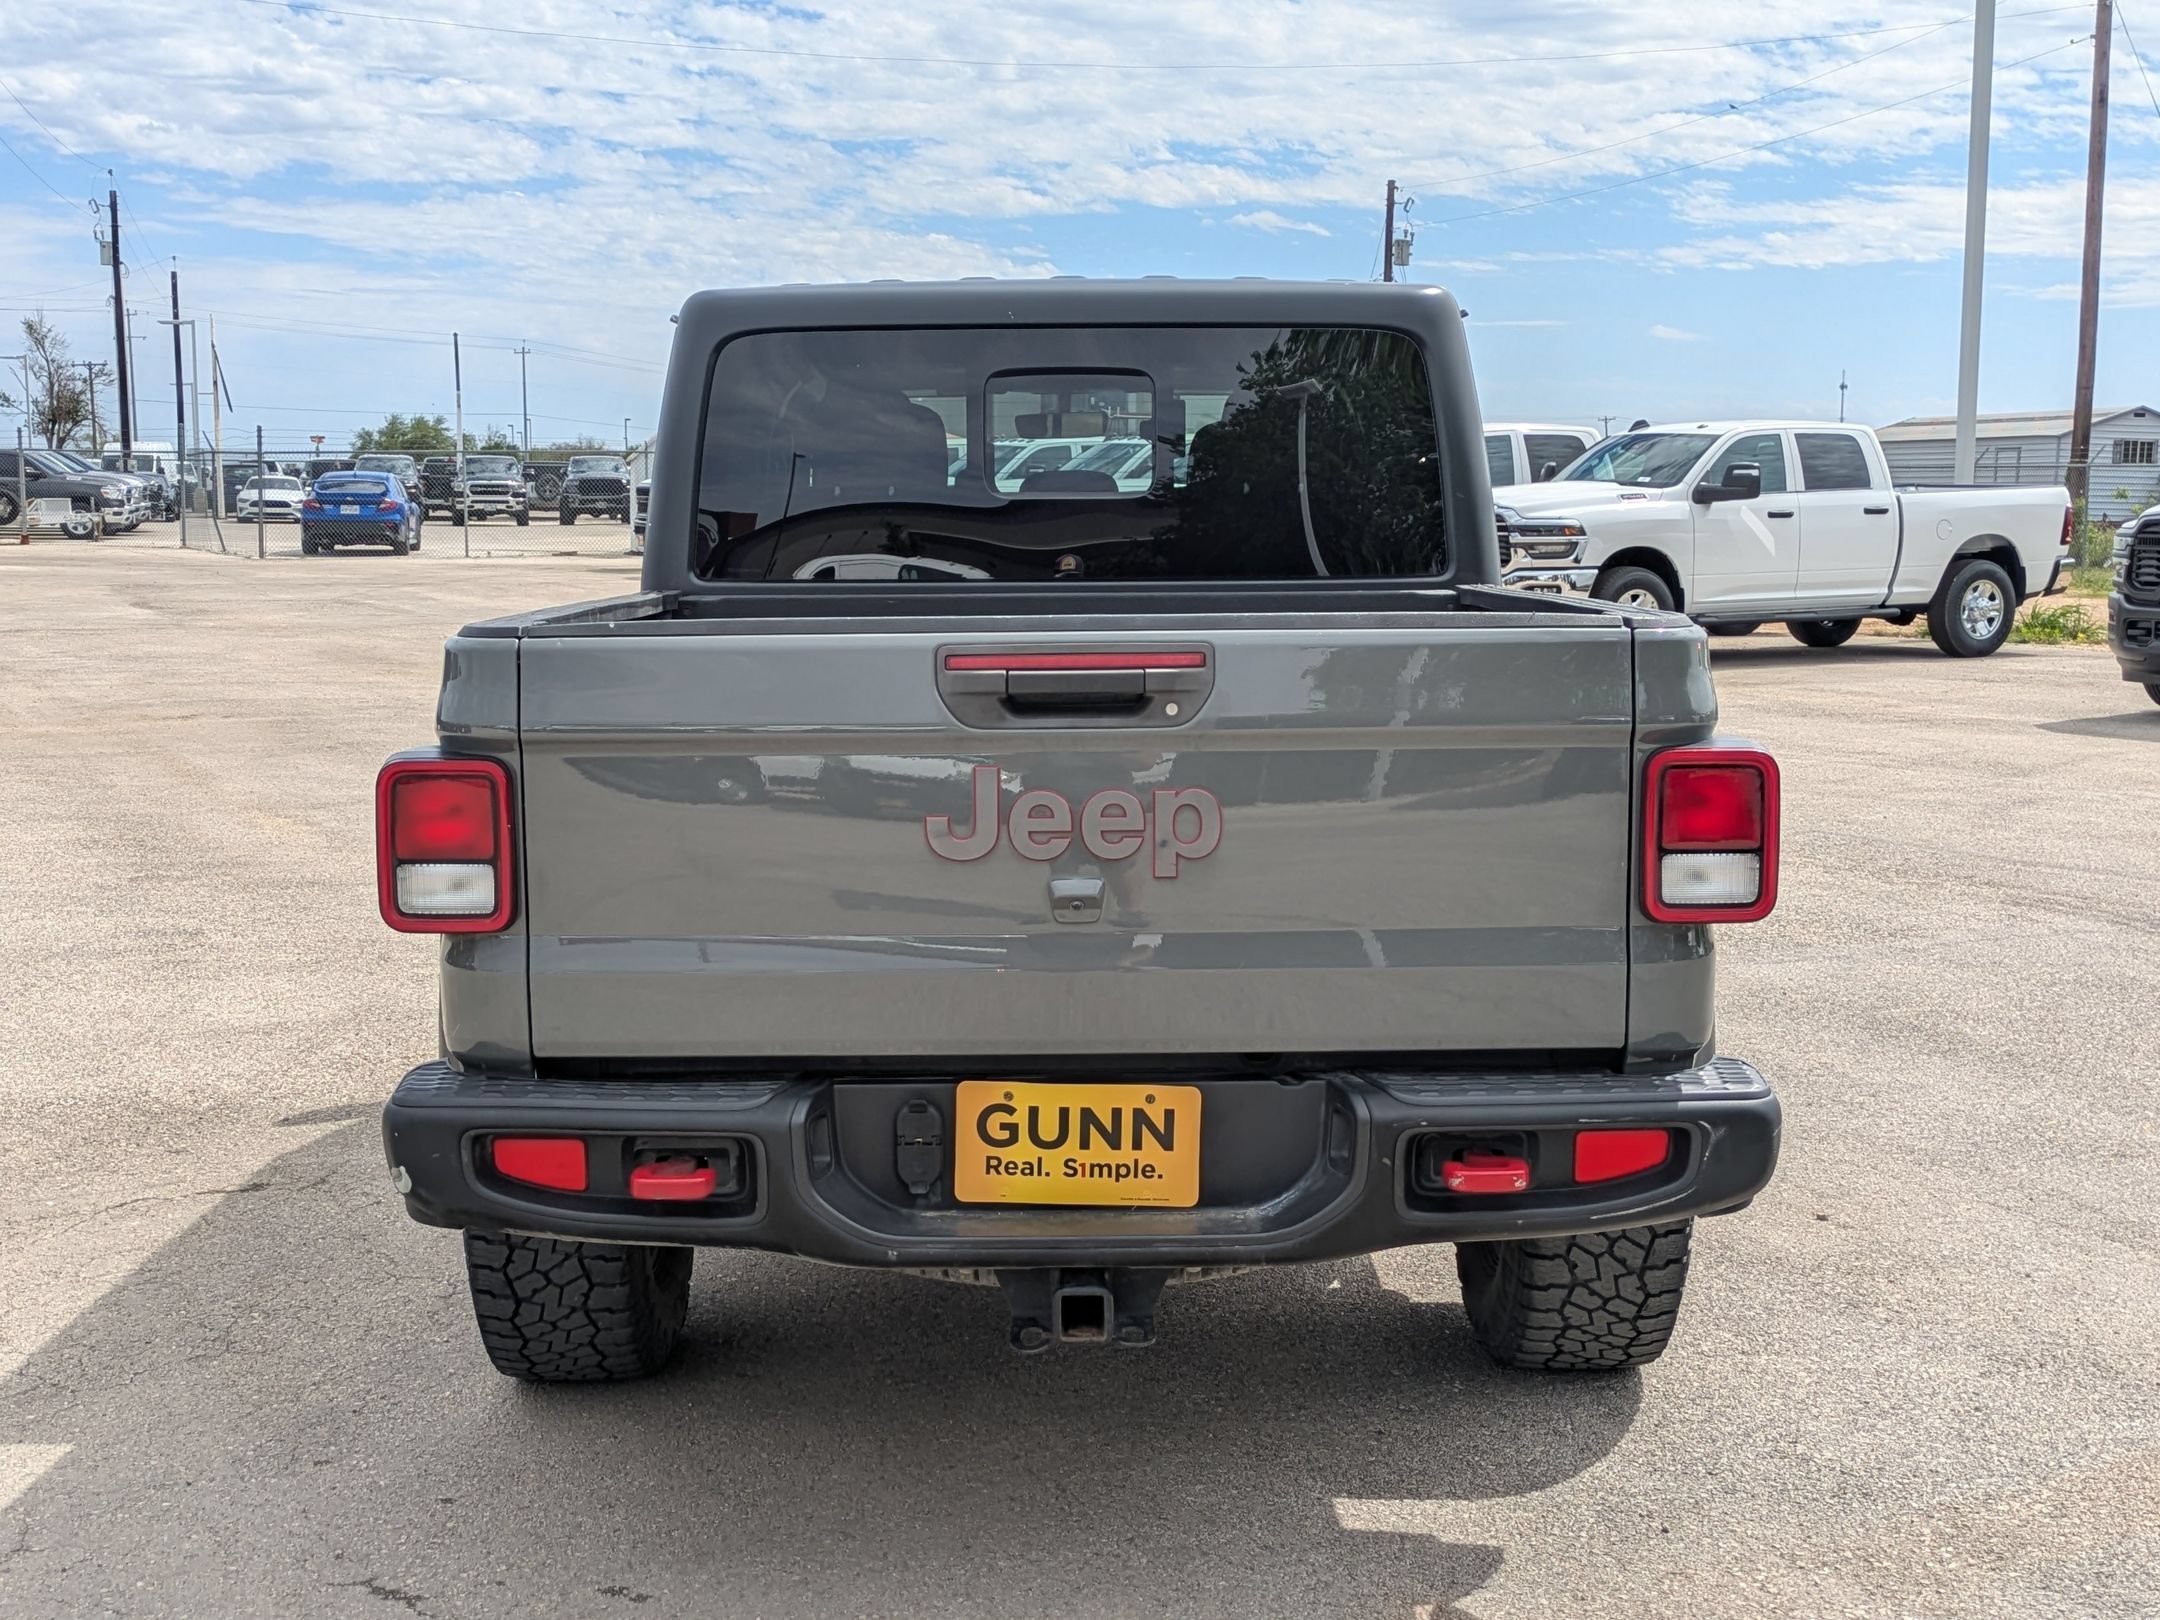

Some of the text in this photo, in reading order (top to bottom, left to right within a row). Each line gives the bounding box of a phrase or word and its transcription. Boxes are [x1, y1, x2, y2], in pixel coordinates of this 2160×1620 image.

[925, 765, 1223, 878] Jeep
[976, 1103, 1175, 1152] GUNN
[985, 1155, 1050, 1177] Real.
